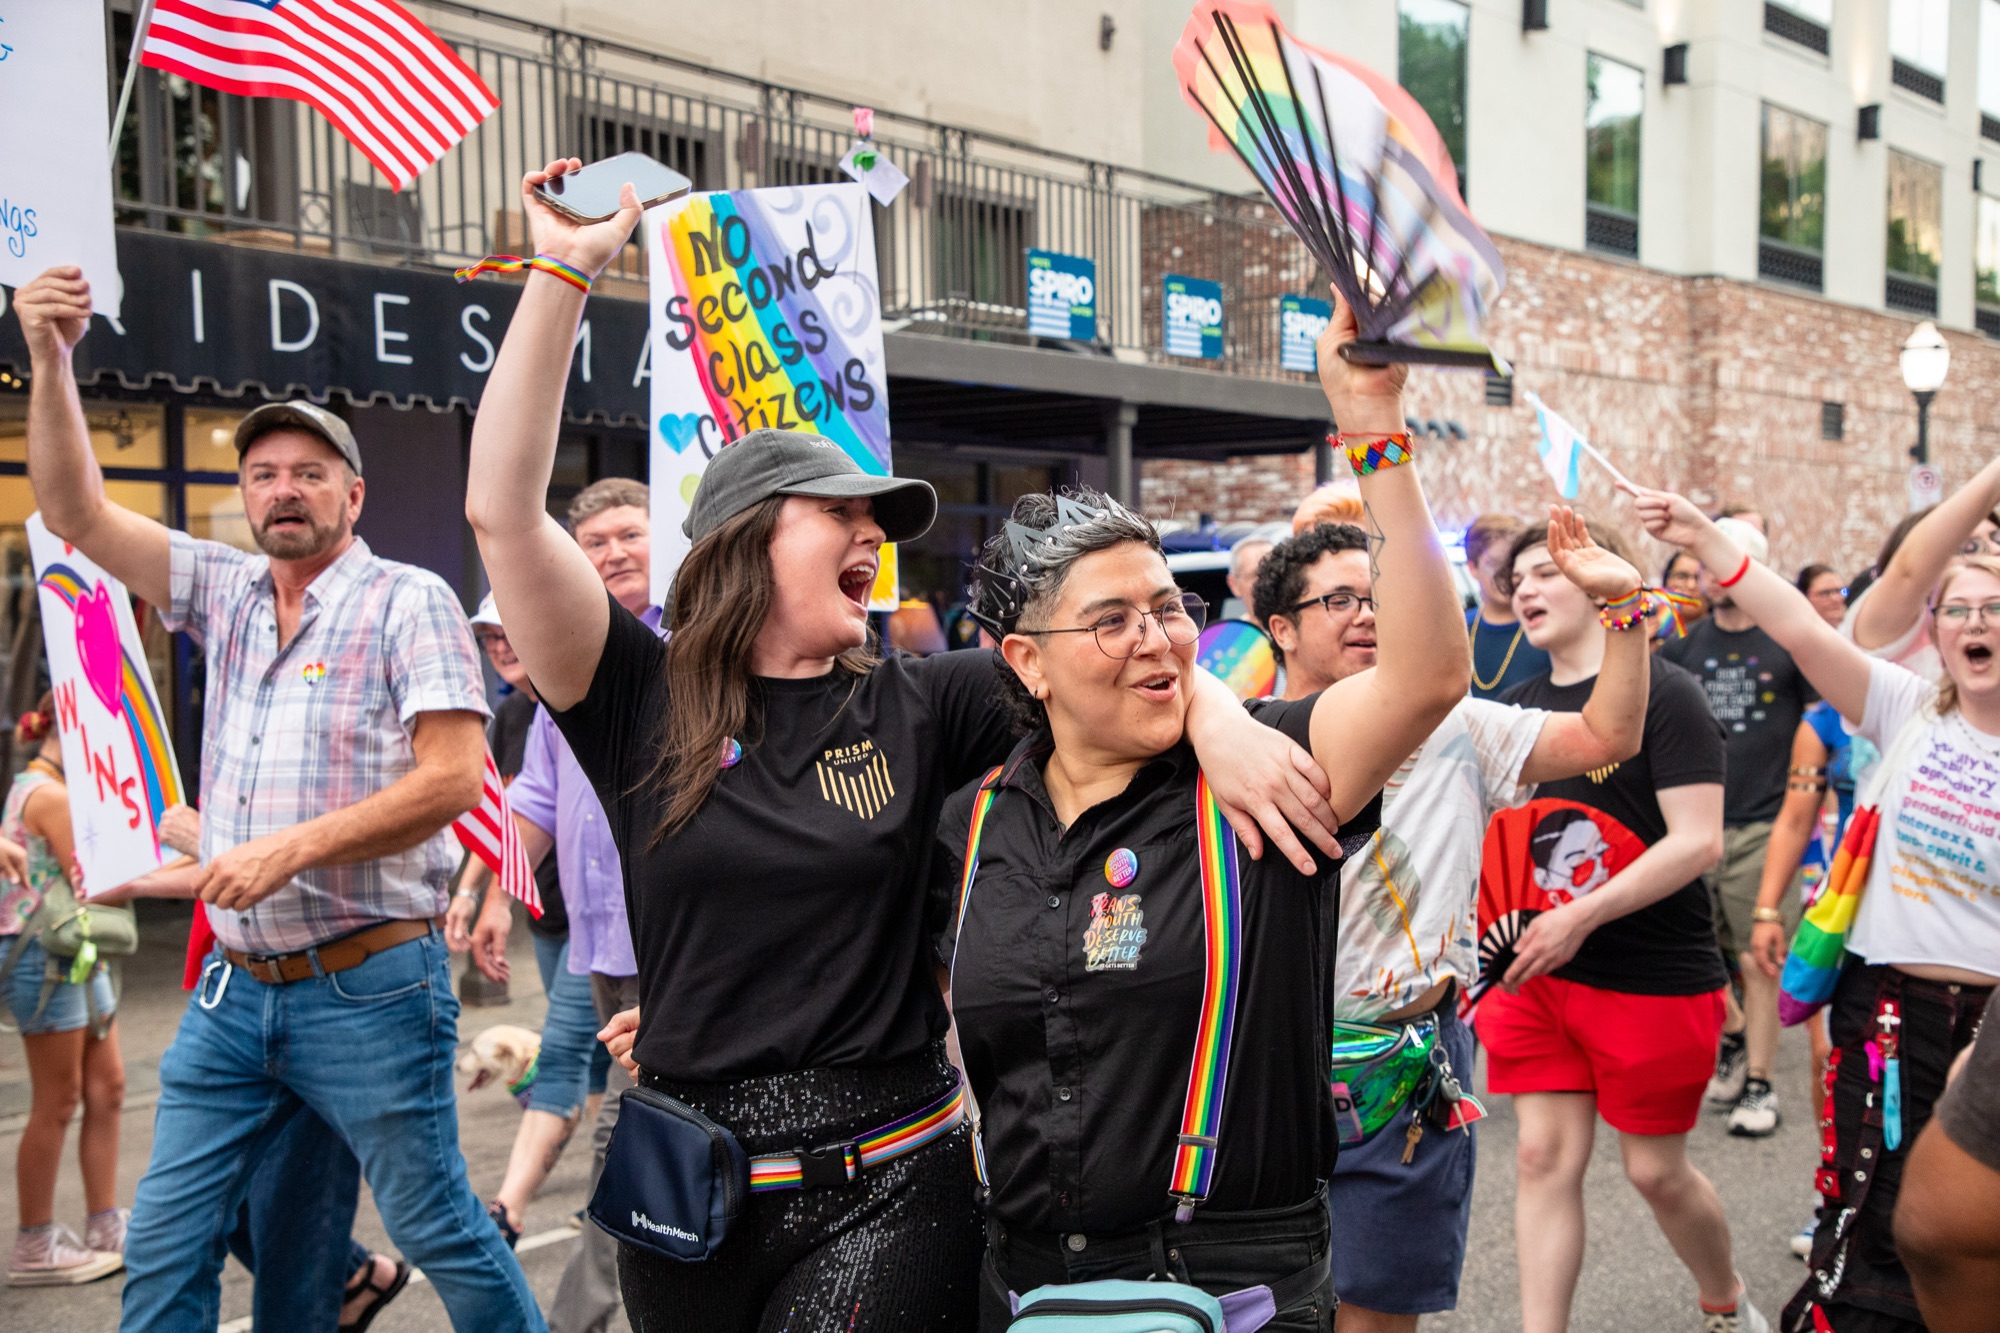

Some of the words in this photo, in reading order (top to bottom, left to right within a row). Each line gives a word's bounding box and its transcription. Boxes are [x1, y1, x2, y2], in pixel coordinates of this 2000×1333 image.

[688, 212, 750, 277] NO
[1029, 267, 1094, 307] SPIRO
[1167, 292, 1223, 328] SPIRO
[55, 677, 142, 831] WINS
[824, 739, 873, 761] PRISM
[833, 752, 869, 766] UNITED
[1897, 812, 1960, 846] intersex
[1113, 866, 1133, 883] BETTER
[1090, 893, 1138, 918] TRANS
[1091, 911, 1141, 935] YOUTH
[1085, 927, 1144, 950] DESERVE
[1087, 945, 1138, 968] BETTER
